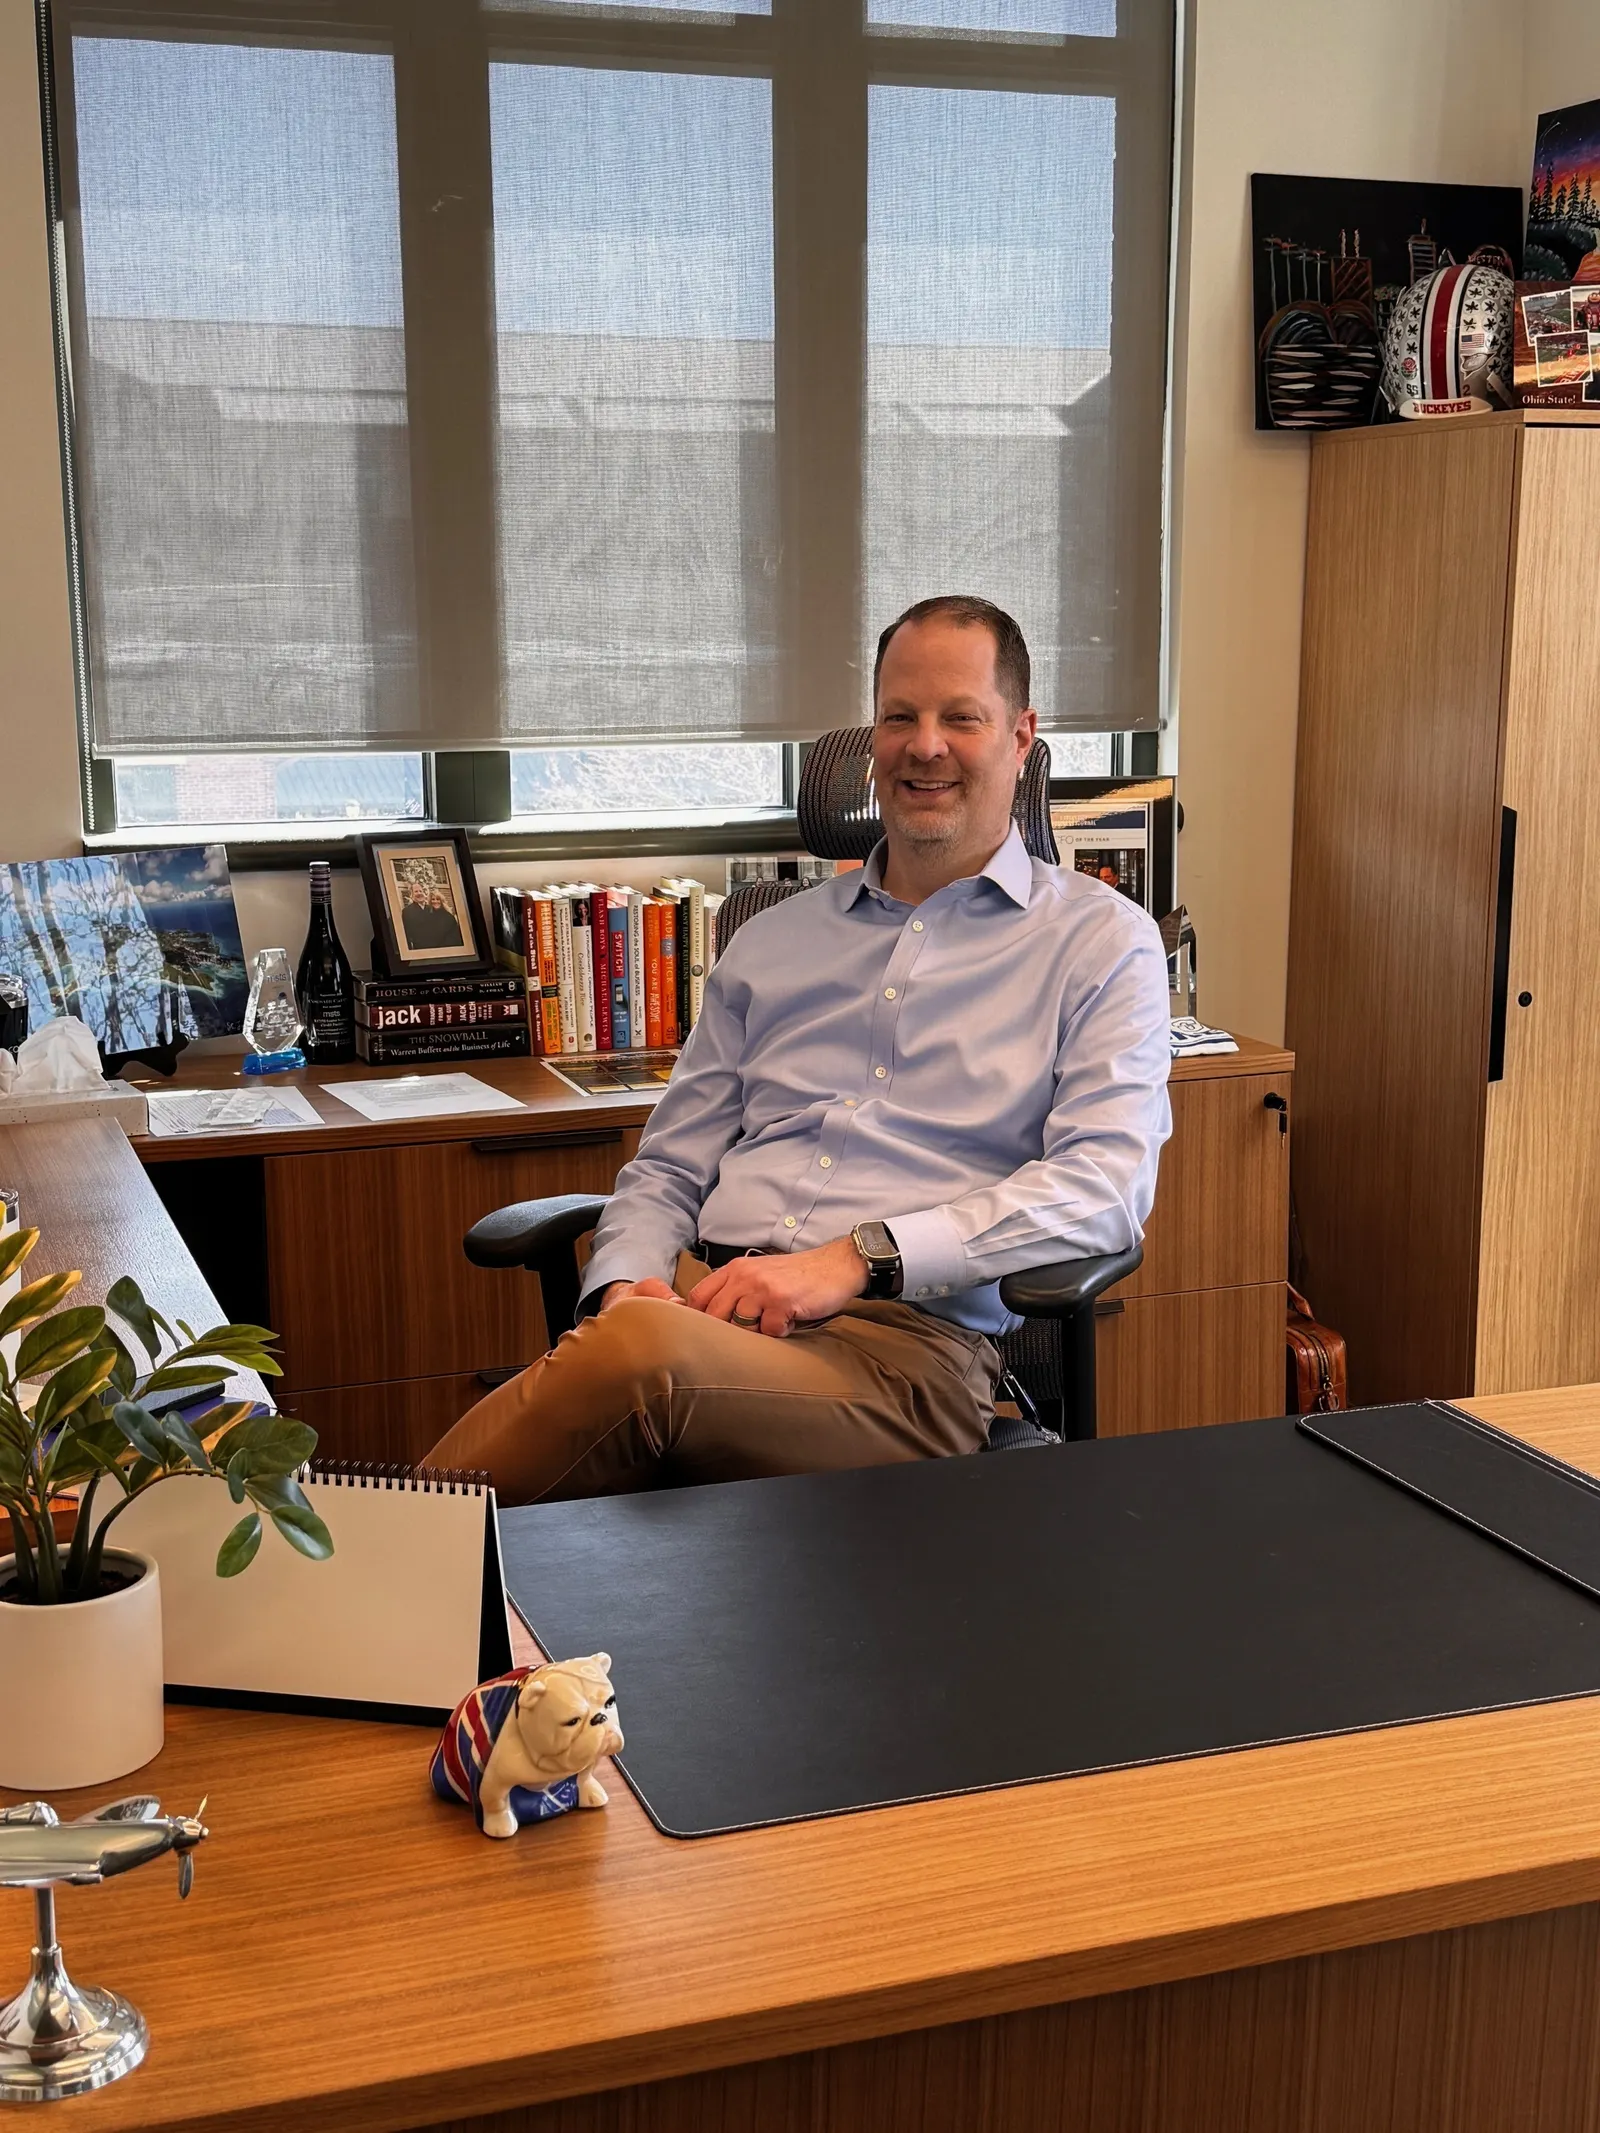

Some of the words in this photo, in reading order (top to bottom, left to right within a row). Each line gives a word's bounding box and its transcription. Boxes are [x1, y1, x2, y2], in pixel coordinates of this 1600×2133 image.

[1462, 384, 1472, 396] 2
[1522, 395, 1545, 404] Ohio
[1548, 394, 1576, 404] State!
[1414, 400, 1472, 414] BUCKEYES
[541, 903, 552, 958] FREAKONOMICS
[614, 934, 622, 972] SWITCH
[665, 942, 672, 951] to
[376, 984, 416, 998] HOUSE
[432, 984, 474, 995] CARDS
[650, 993, 660, 1022] AWESOME
[377, 1005, 422, 1030] jack
[409, 1036, 426, 1045] THE
[429, 1032, 488, 1044] SNOWBALL
[390, 1047, 416, 1056] Warren
[418, 1045, 442, 1054] Buffett
[462, 1043, 490, 1051] Business
